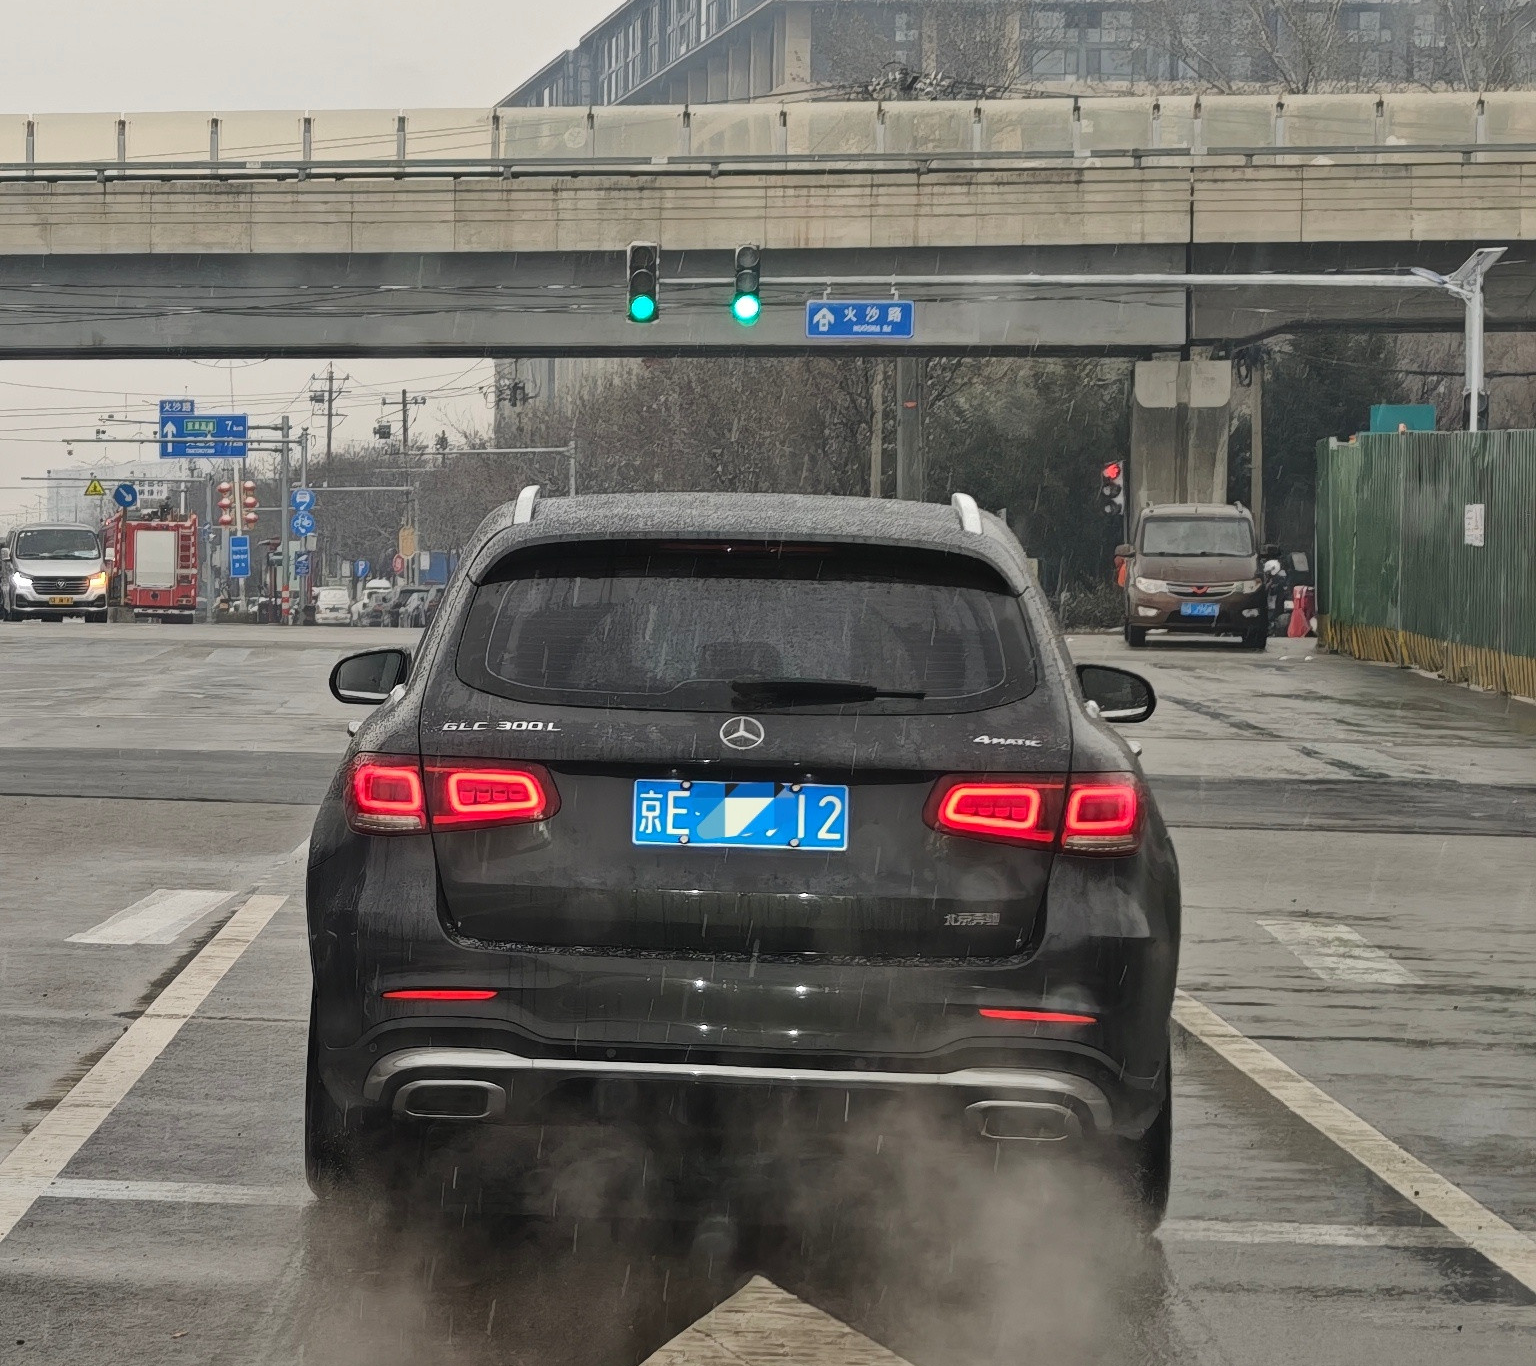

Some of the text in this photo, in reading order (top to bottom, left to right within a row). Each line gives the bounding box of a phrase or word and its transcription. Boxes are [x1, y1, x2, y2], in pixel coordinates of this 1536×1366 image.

[843, 306, 902, 322] 火沙路
[443, 721, 489, 731] GLC
[973, 735, 1043, 747] 4MATIC
